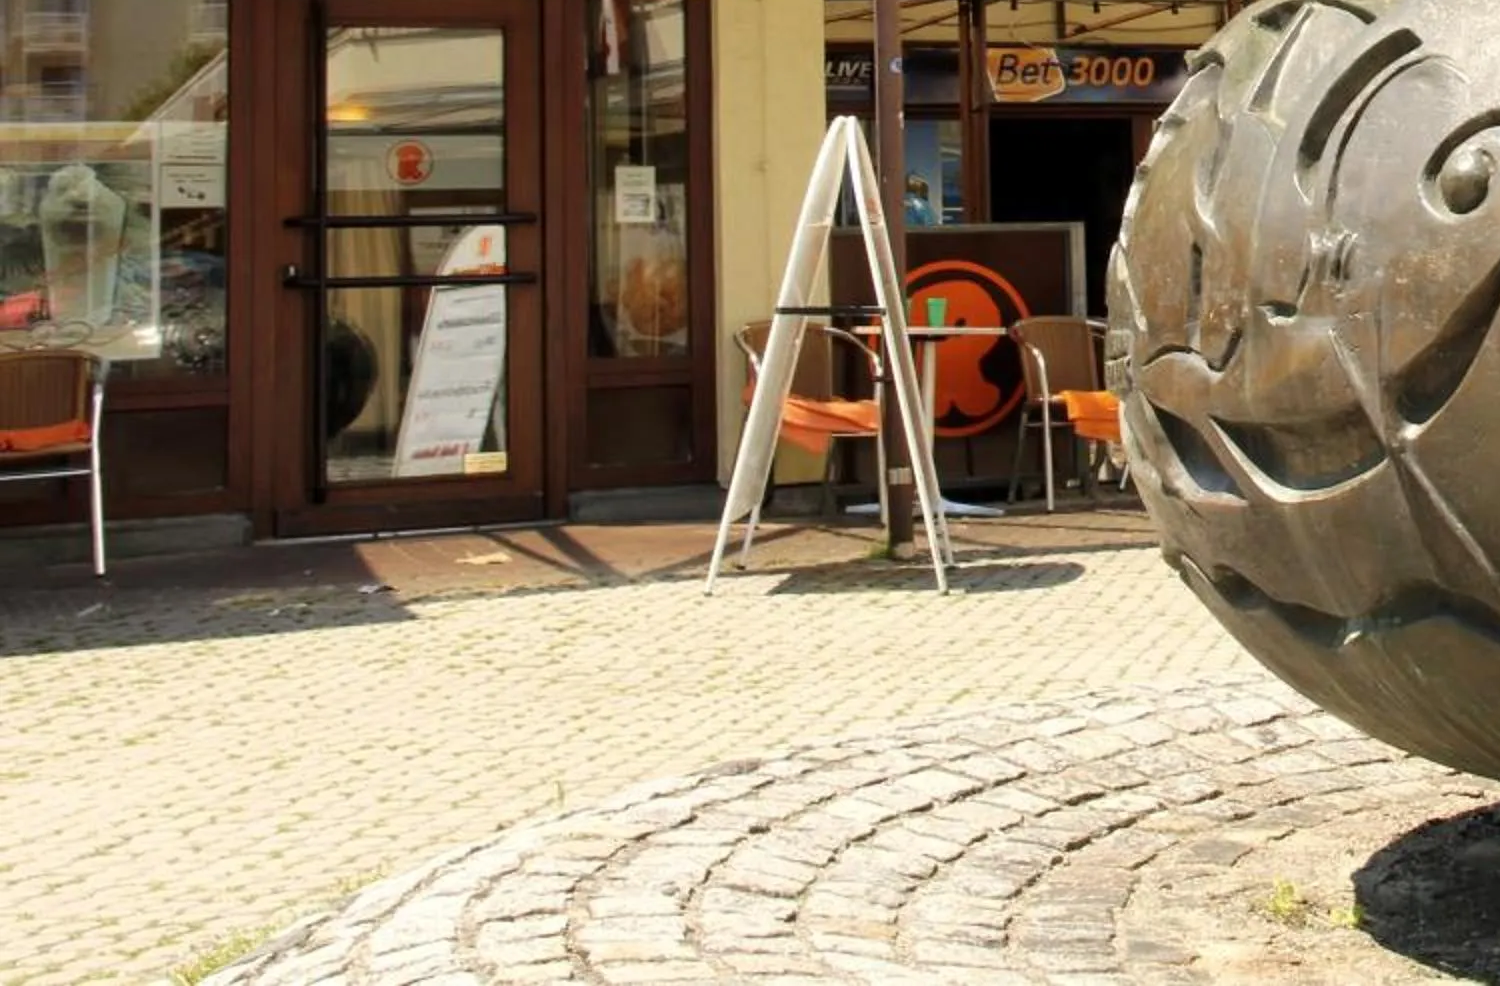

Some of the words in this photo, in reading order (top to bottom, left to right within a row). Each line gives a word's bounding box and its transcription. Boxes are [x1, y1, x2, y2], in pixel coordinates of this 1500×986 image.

[825, 60, 873, 78] LIVE
[996, 53, 1061, 85] Bet
[1068, 56, 1154, 87] 3000
